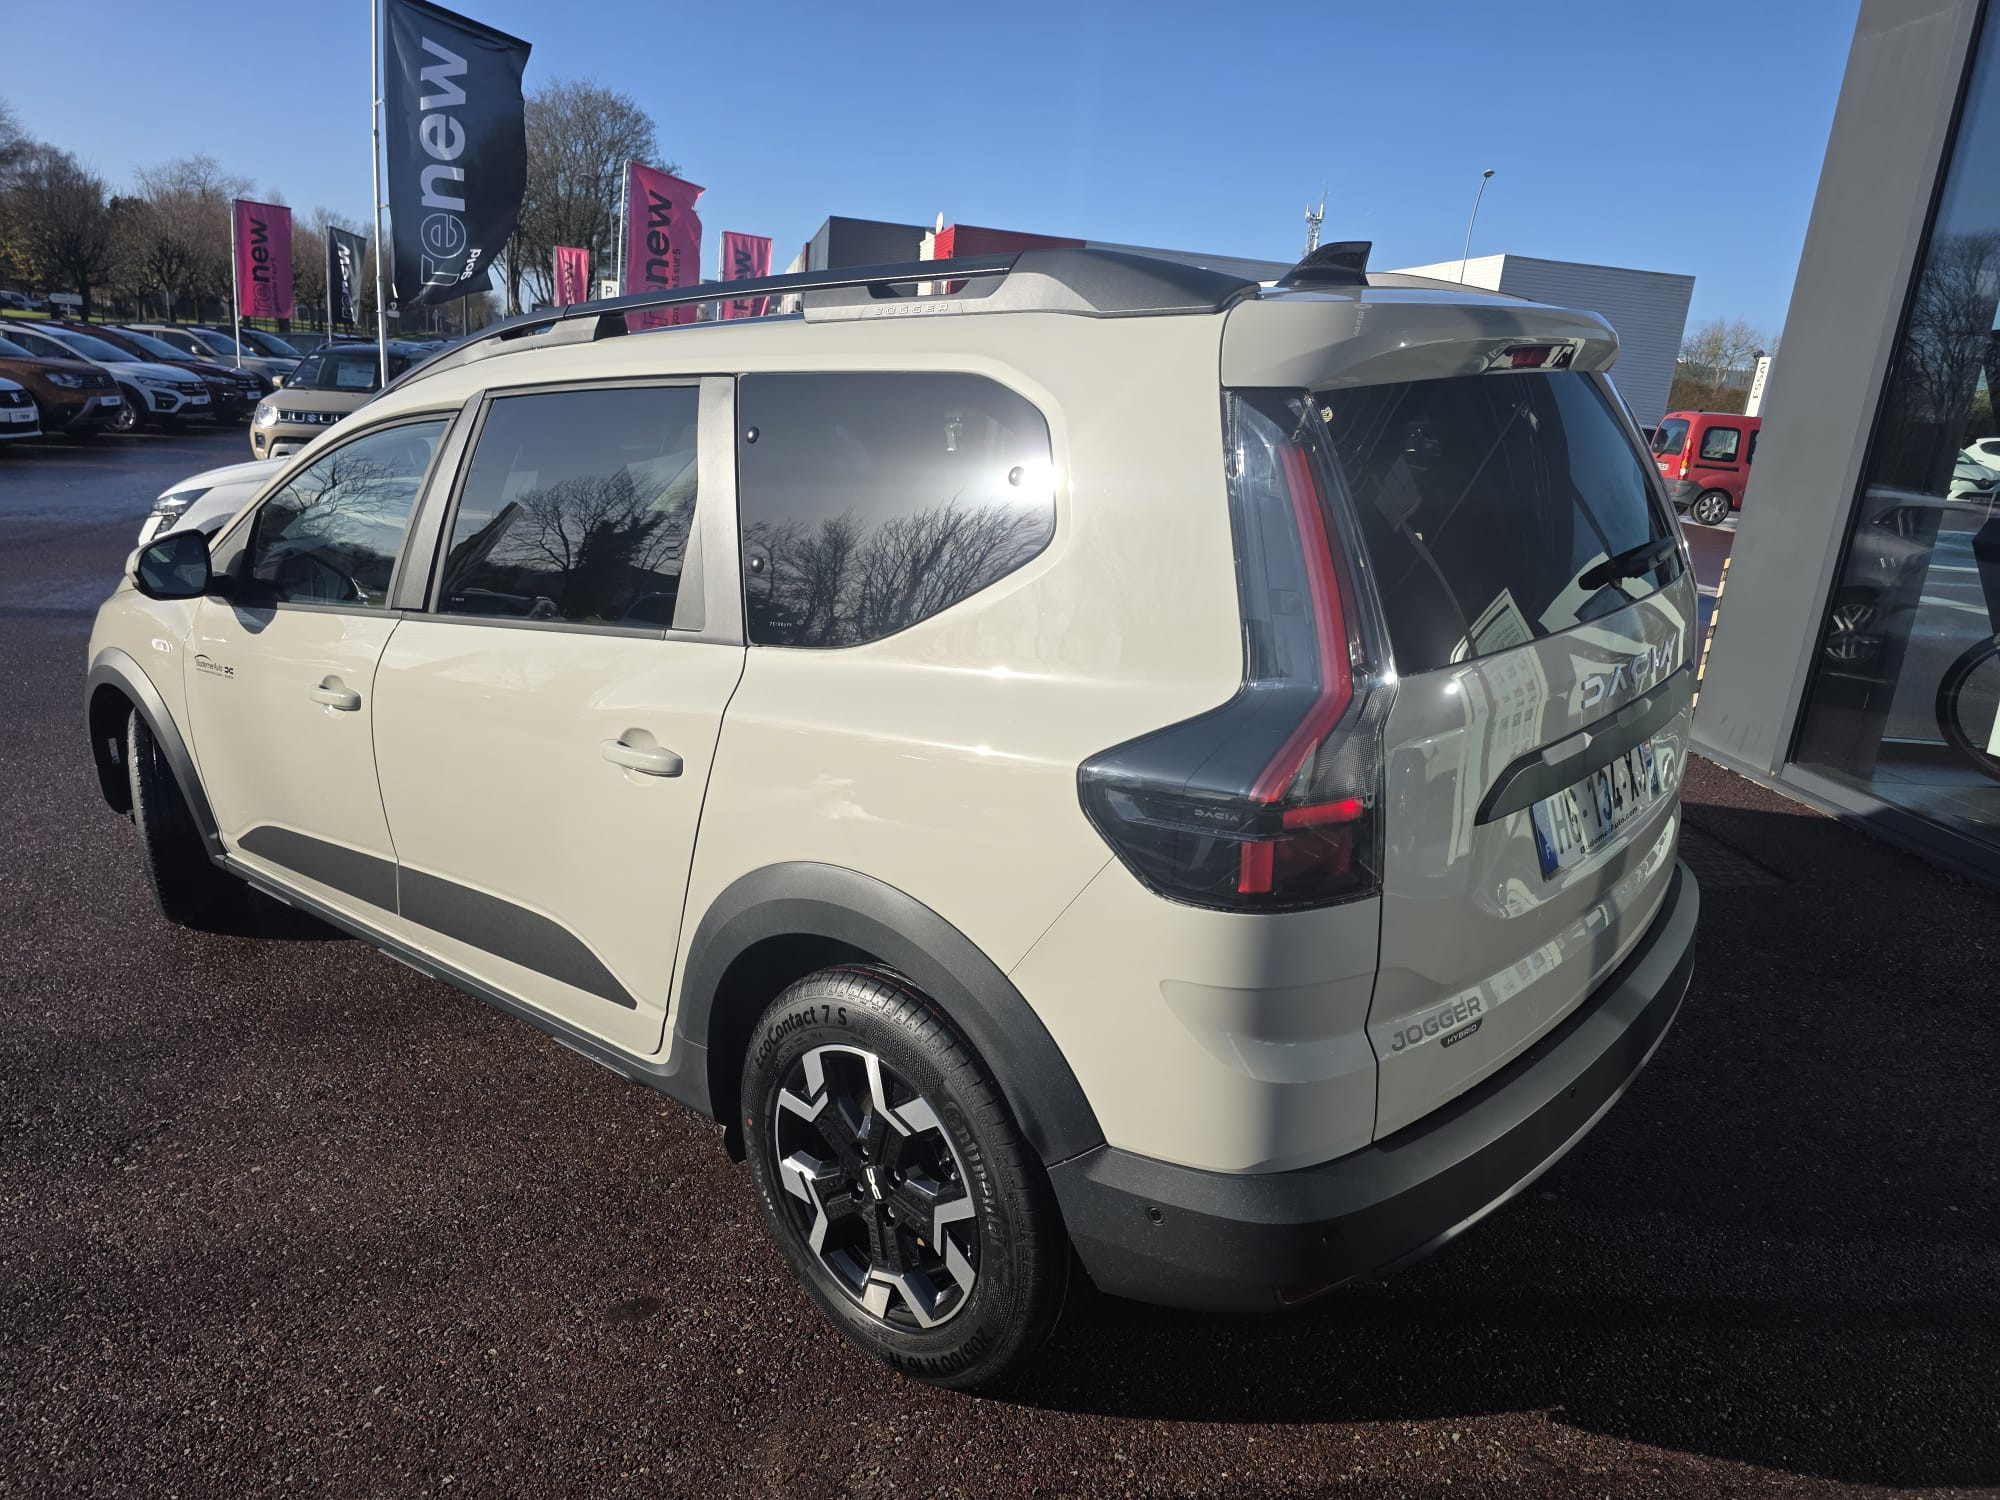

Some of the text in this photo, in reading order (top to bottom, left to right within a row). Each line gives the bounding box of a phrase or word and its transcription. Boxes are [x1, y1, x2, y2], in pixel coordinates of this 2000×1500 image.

[418, 36, 468, 287] renew
[250, 218, 273, 313] renew
[460, 248, 482, 281] gold
[642, 189, 672, 328] rnew
[605, 286, 613, 297] P
[874, 303, 949, 316] JOGGER
[1752, 361, 1768, 399] ESSAI
[1194, 809, 1240, 822] DACIA
[1580, 804, 1639, 855] BdemerAuto.com
[753, 1006, 818, 1068] EcoContact
[821, 1004, 830, 1026] 7
[837, 1006, 848, 1027] S
[1391, 996, 1482, 1052] JOGGER
[1446, 1023, 1478, 1045] HYBRID
